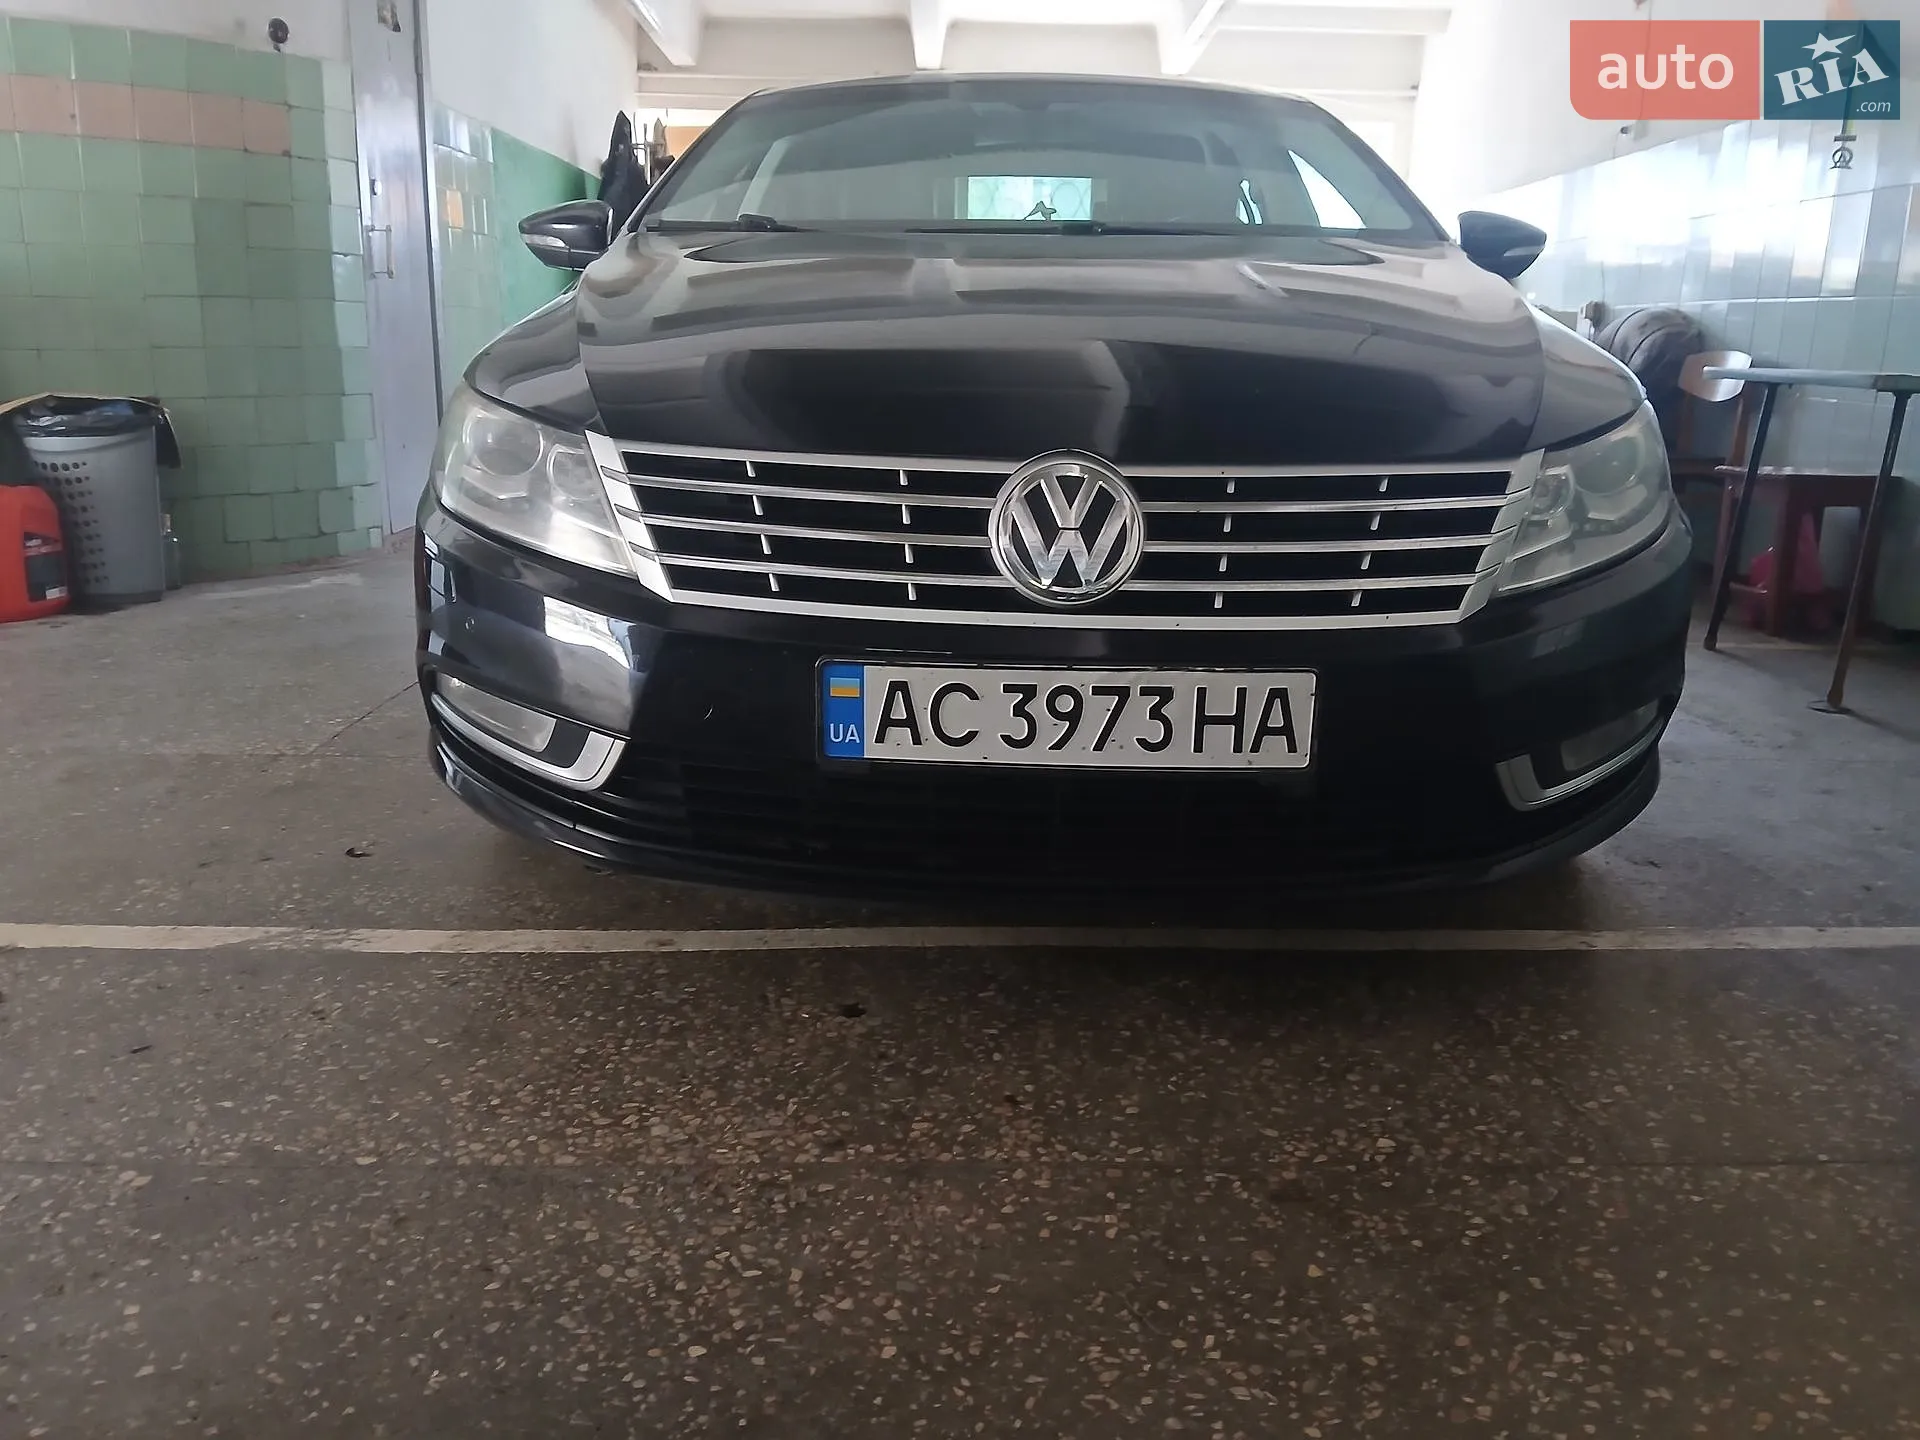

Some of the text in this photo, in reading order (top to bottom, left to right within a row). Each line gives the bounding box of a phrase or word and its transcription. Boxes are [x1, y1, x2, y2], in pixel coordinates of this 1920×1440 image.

[829, 722, 861, 744] UA
[873, 679, 1299, 755] AC 3973 HA
